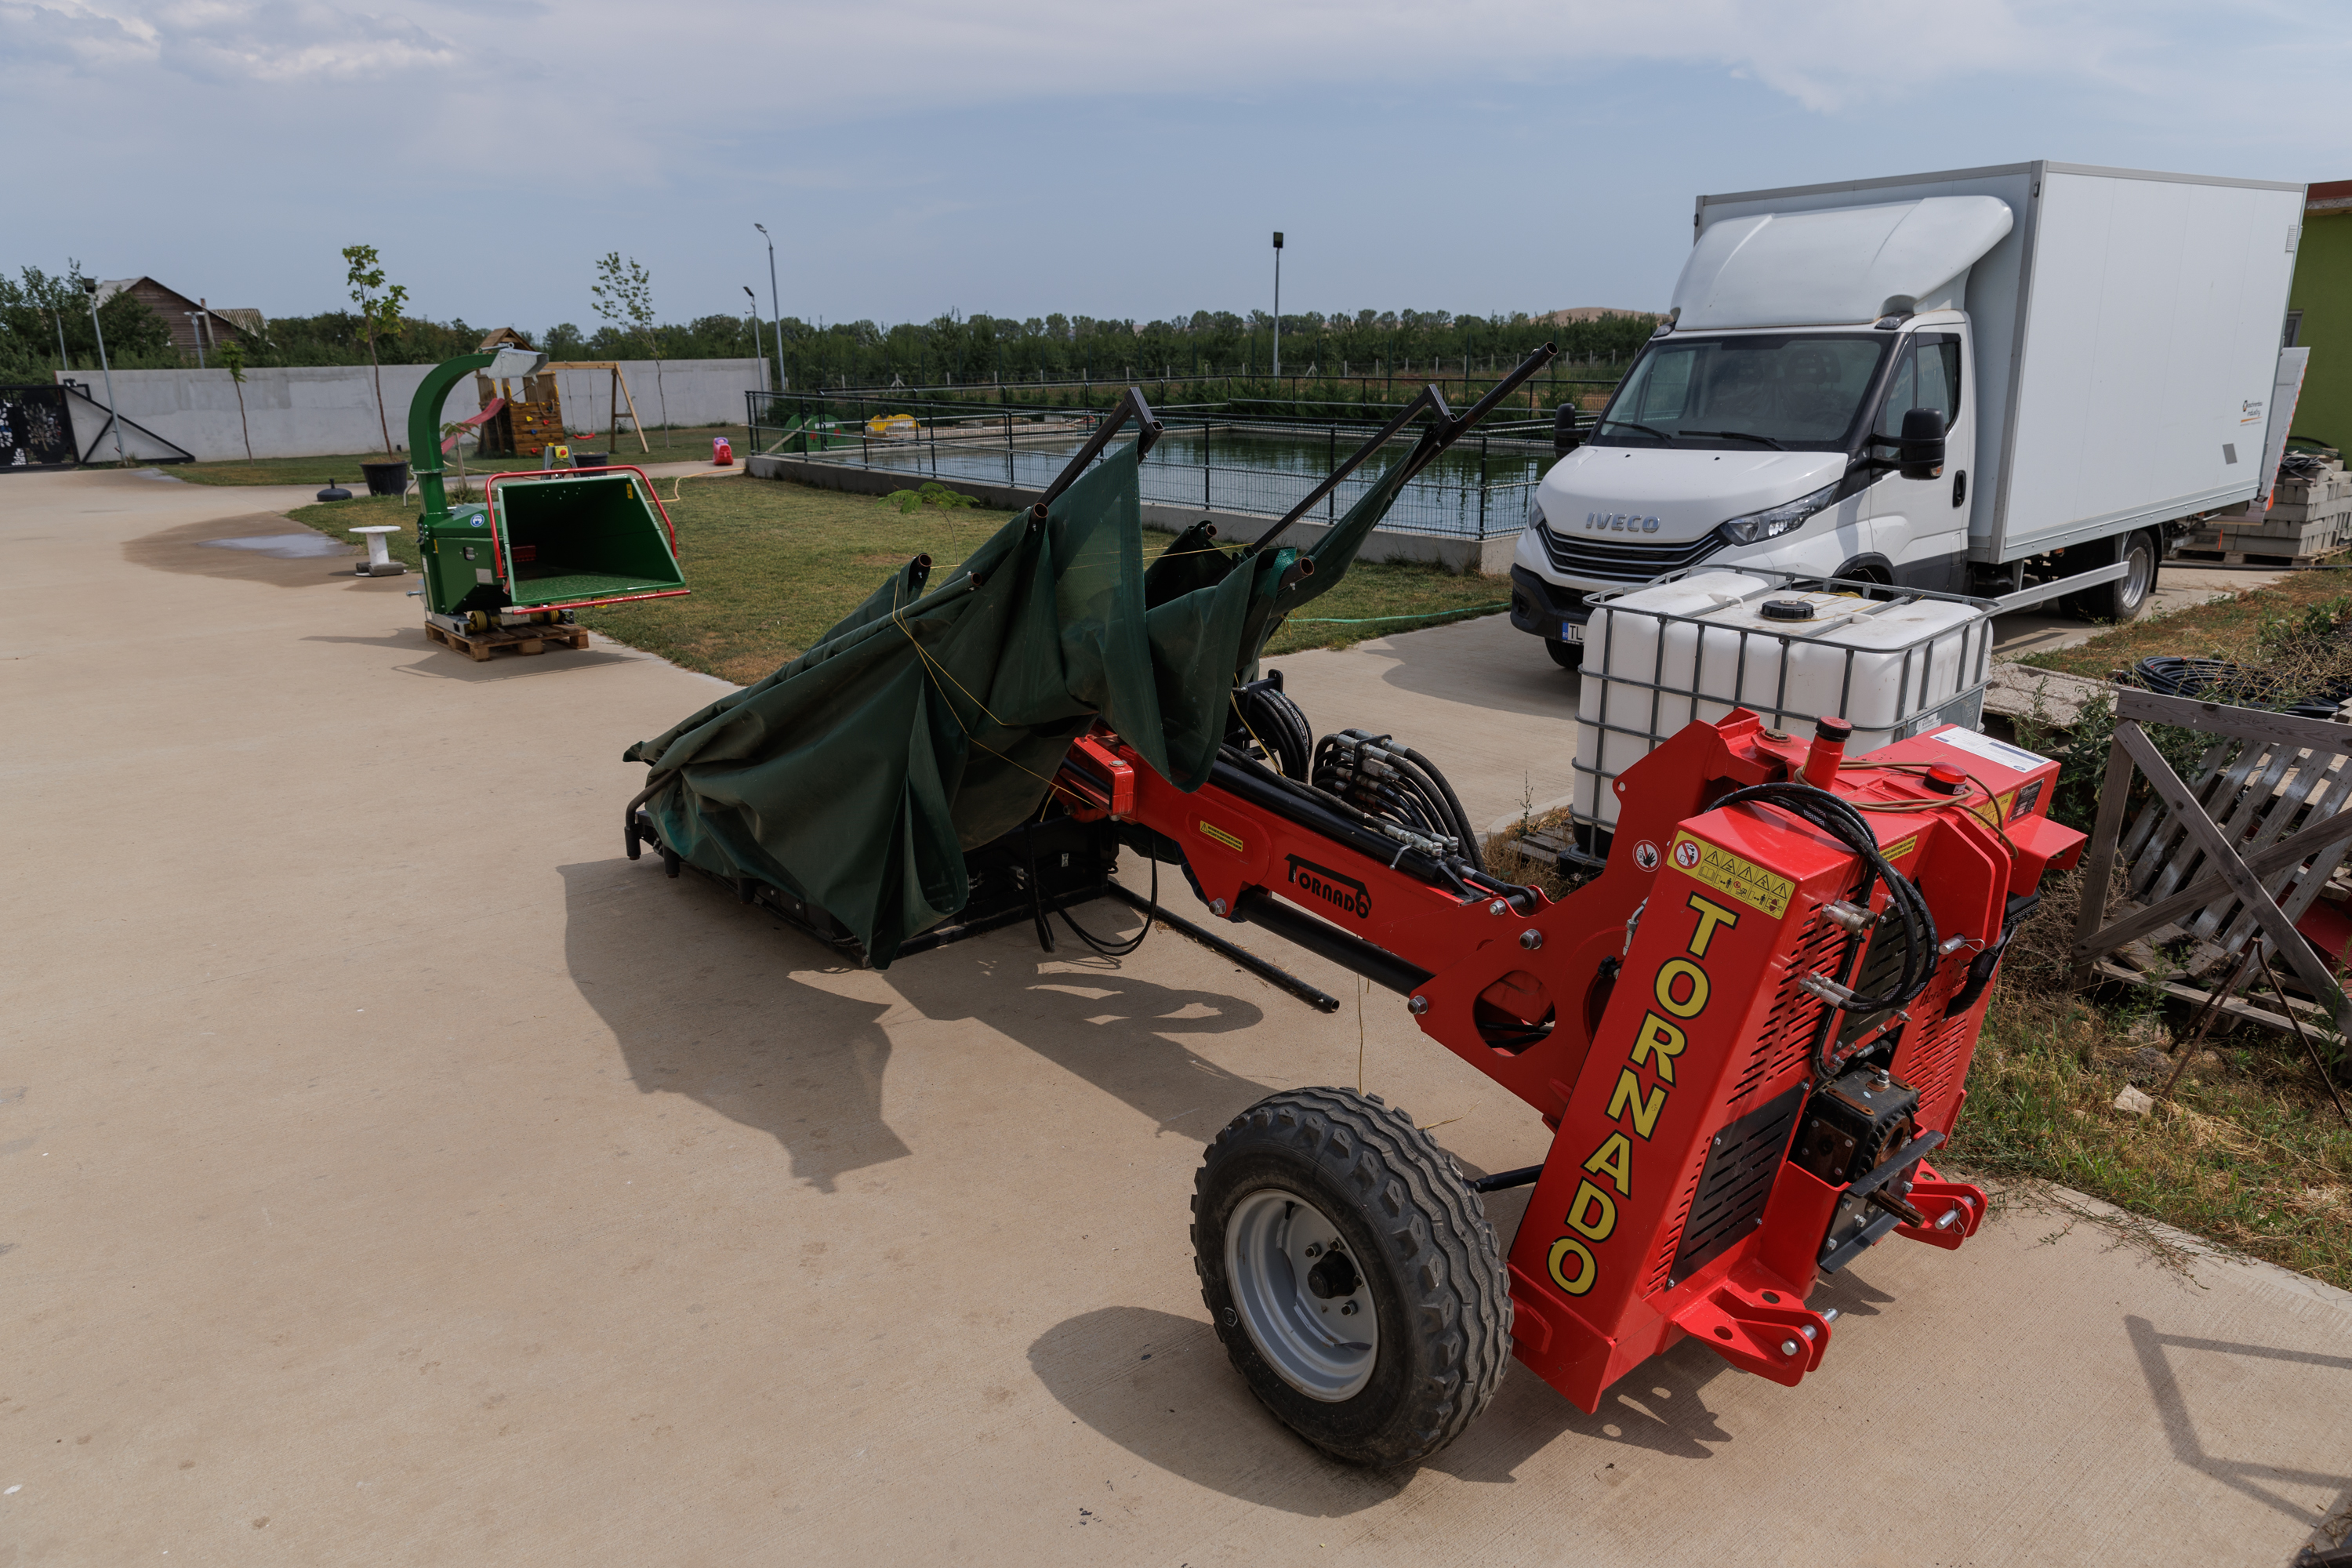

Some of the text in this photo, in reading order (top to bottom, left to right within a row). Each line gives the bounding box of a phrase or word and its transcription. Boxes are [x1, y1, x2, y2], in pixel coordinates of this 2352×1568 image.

[1585, 512, 1661, 533] IVECO
[1570, 625, 1583, 641] TL
[1260, 690, 1270, 699] MADE
[1273, 699, 1283, 710] ITALY
[1284, 853, 1372, 919] TORNADO
[1546, 891, 1740, 1298] TORNADO
